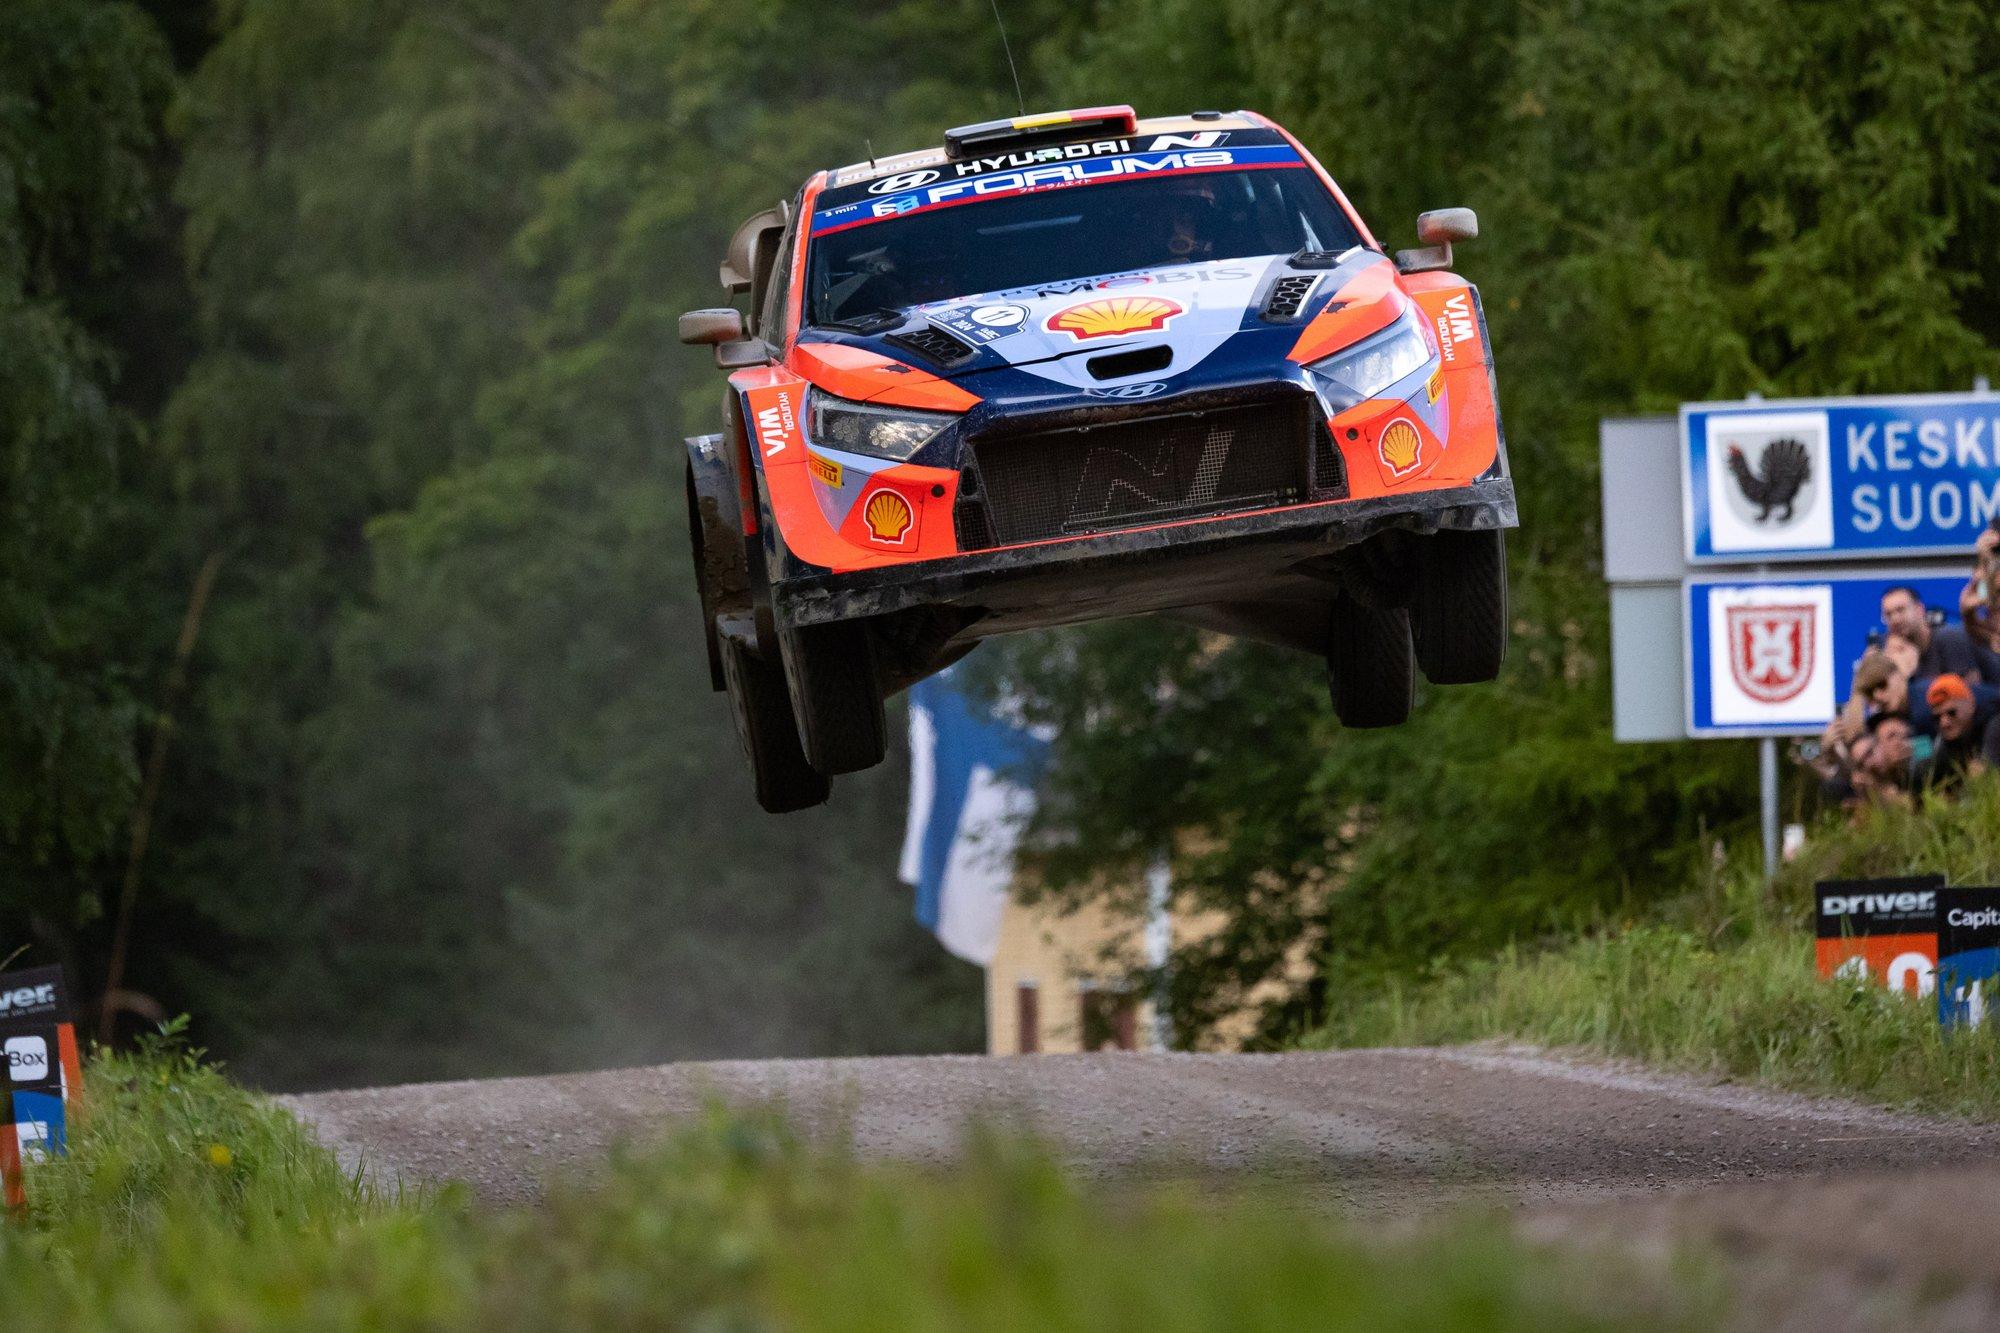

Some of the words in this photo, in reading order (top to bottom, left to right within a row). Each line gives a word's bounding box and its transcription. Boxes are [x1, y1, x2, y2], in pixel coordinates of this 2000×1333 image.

[956, 139, 1131, 176] HYUNDAI
[928, 152, 1233, 204] FORUM8
[835, 205, 858, 216] min
[1037, 267, 1253, 299] MOBIS
[1437, 317, 1455, 361] HYUNDAI
[777, 391, 795, 431] HYUNDAI
[1947, 906, 2000, 930] Capit
[8, 1051, 46, 1067] Box
